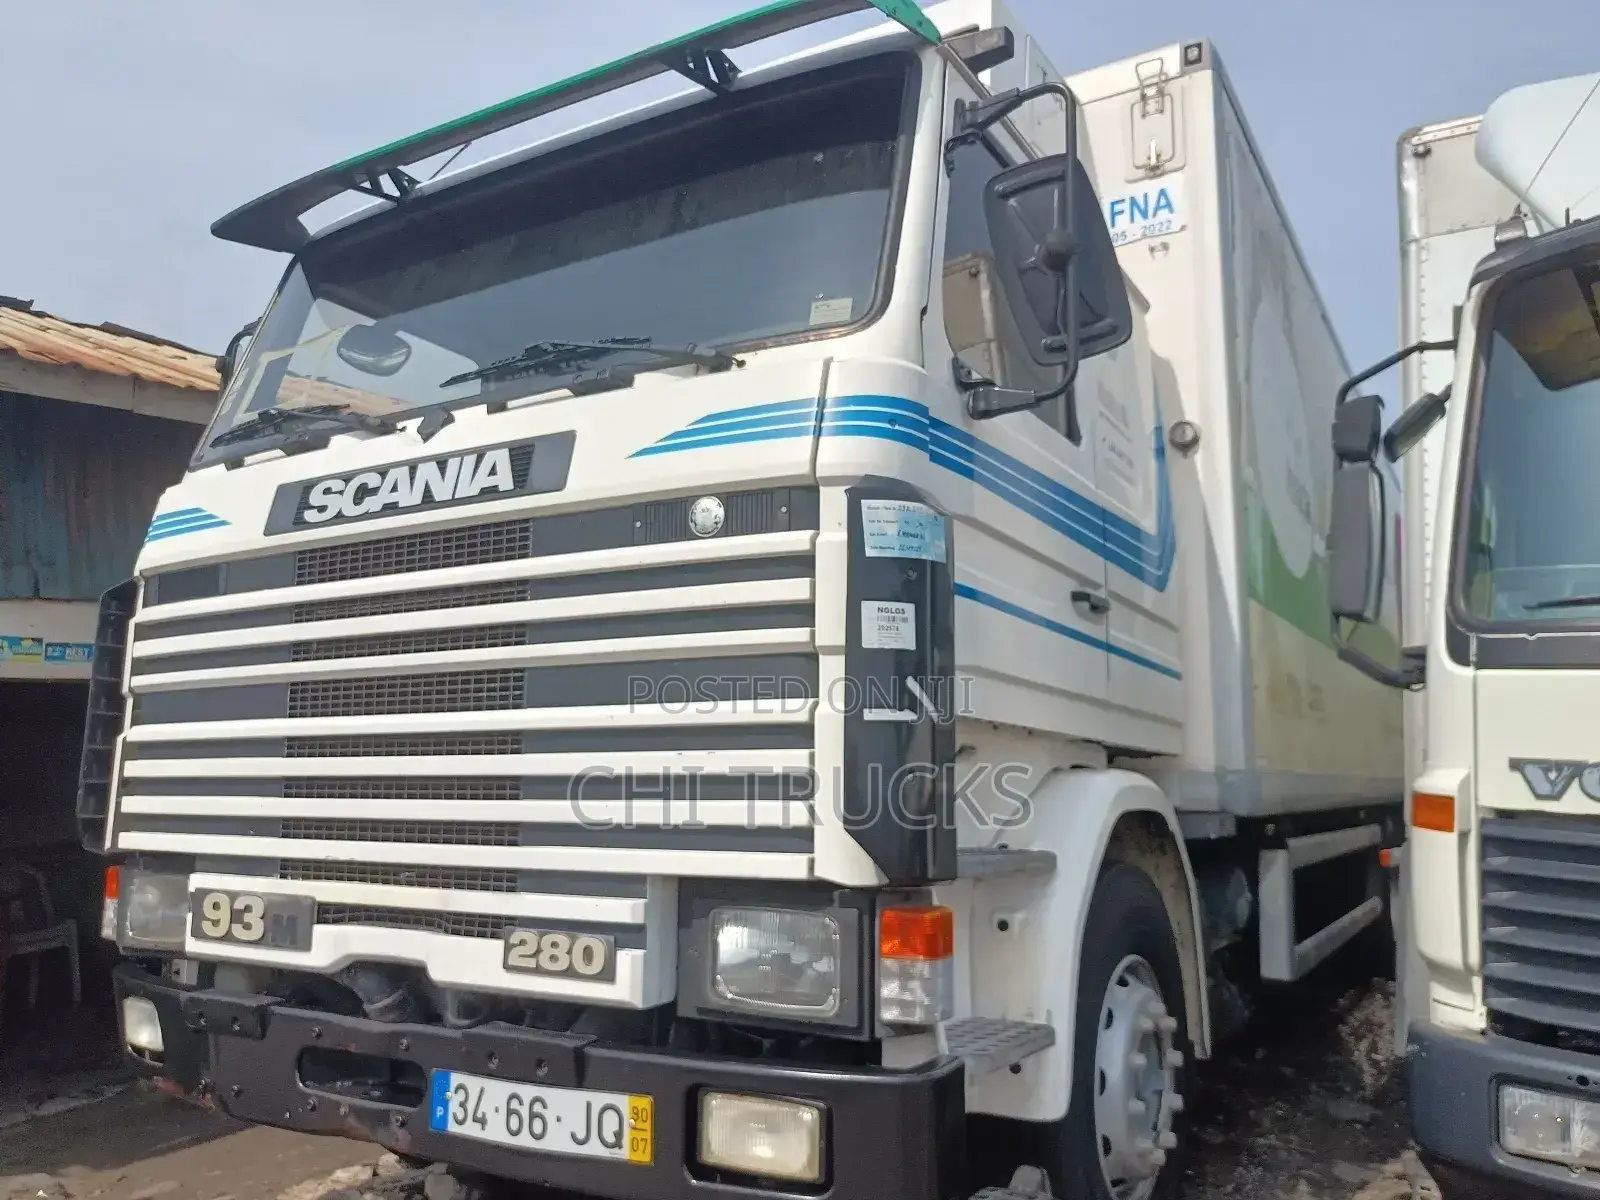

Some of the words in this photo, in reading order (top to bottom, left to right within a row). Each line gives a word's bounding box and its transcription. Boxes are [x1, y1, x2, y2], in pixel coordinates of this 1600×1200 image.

[1109, 187, 1175, 229] FNA
[1140, 219, 1173, 237] 2022
[302, 447, 516, 523] SCANIA
[507, 930, 606, 976] 280
[435, 1106, 445, 1119] P
[631, 1136, 648, 1155] 07
